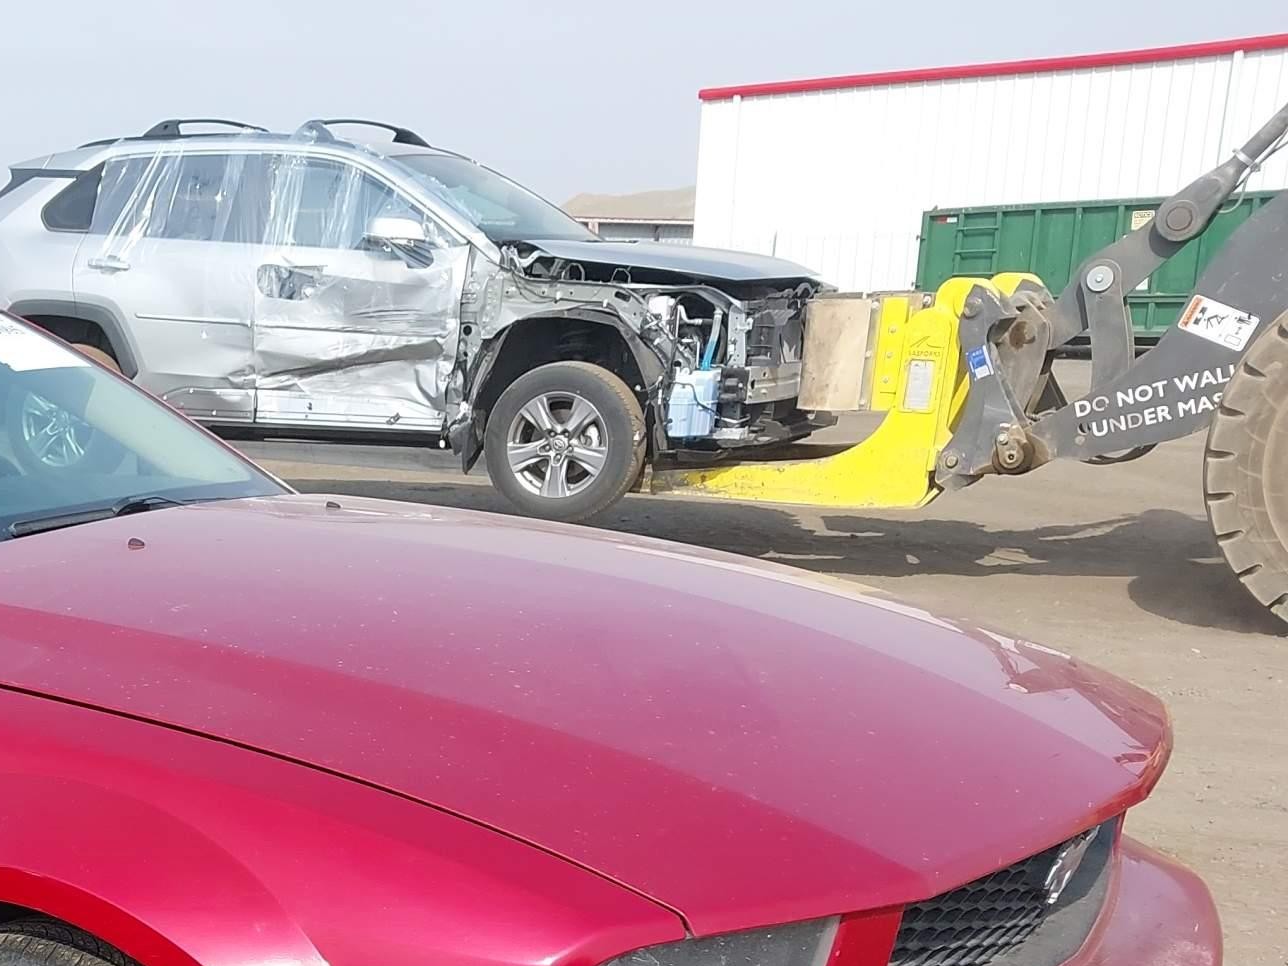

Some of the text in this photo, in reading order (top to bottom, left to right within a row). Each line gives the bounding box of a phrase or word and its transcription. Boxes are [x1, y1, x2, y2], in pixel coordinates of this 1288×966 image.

[1074, 396, 1110, 418] DO
[1116, 380, 1168, 408] NOT
[1091, 405, 1172, 437] UNDER
